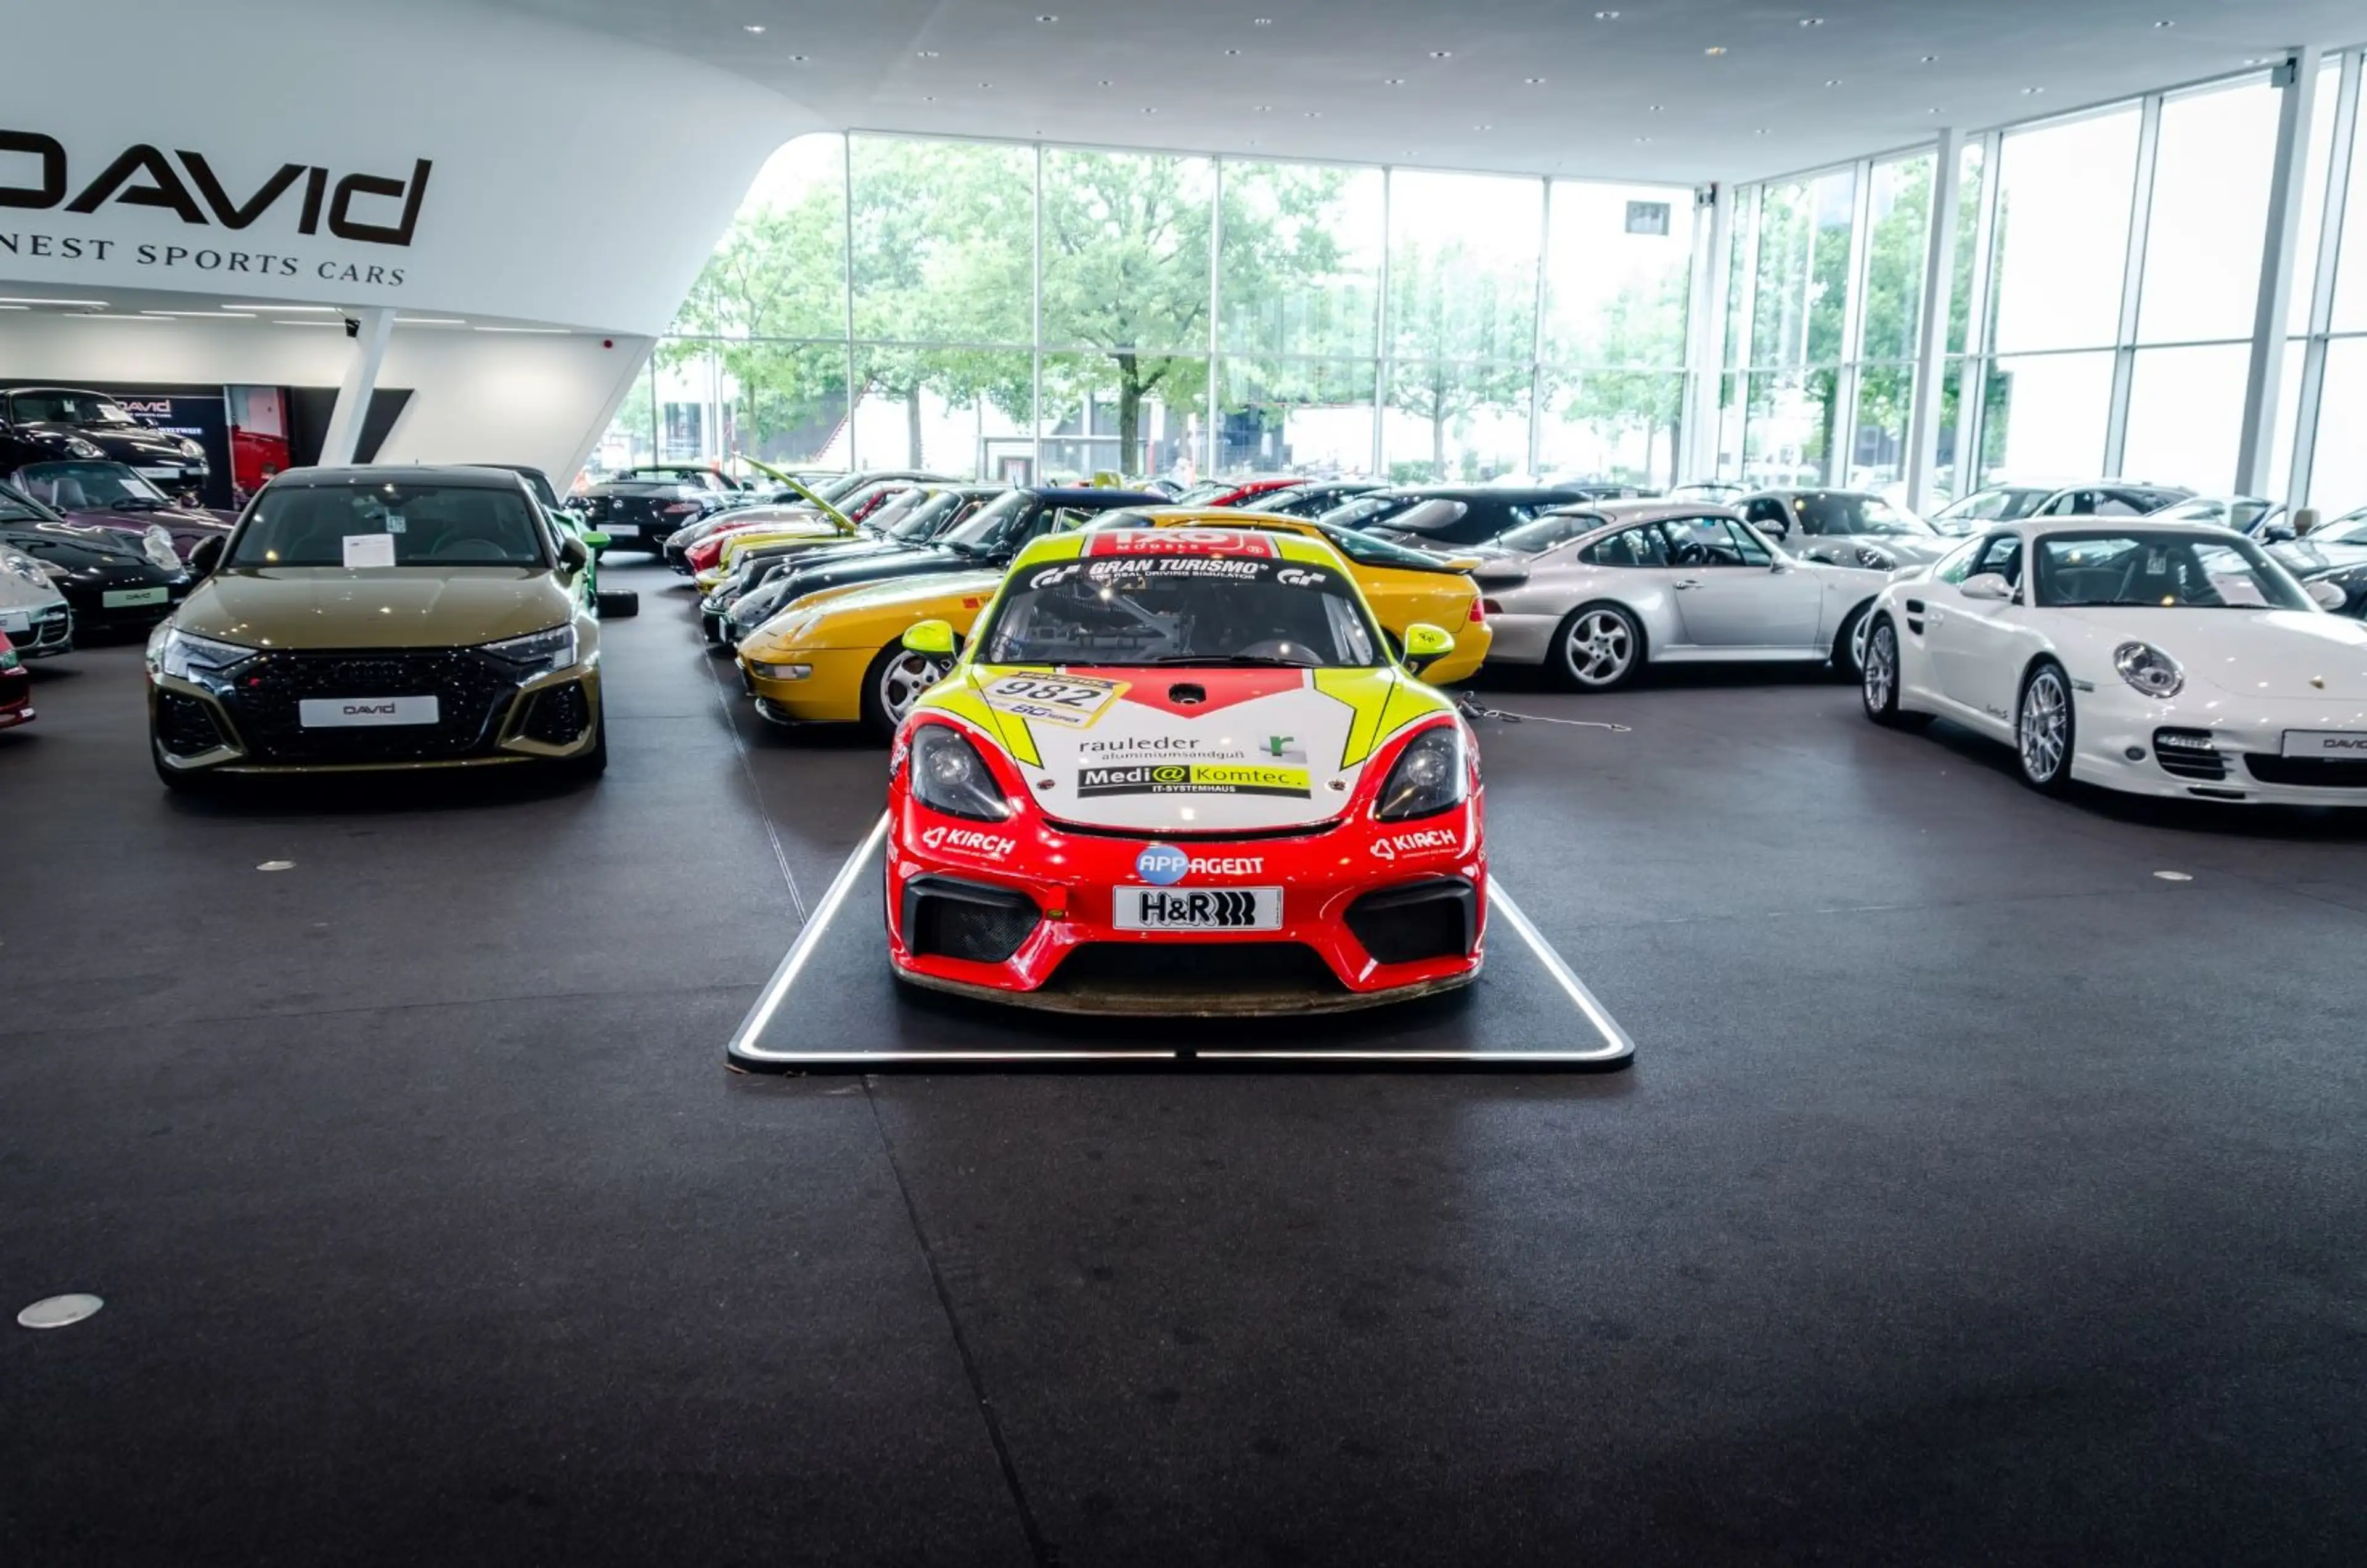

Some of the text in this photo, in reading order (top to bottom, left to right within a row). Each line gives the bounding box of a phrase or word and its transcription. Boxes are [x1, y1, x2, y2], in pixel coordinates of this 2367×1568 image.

[137, 244, 299, 276] SPORTS
[317, 261, 406, 286] CARS
[1089, 558, 1155, 574] GRAN
[1192, 571, 1256, 579] SIMULATOR
[996, 681, 1102, 706] 982
[1080, 737, 1201, 753] rauleder
[1084, 766, 1185, 785] Medi@
[1152, 785, 1237, 793] IT-SYSTEMHAUS
[947, 828, 1016, 854] KIRCH
[1392, 829, 1457, 851] KIRCH
[1140, 891, 1216, 926] H&R
